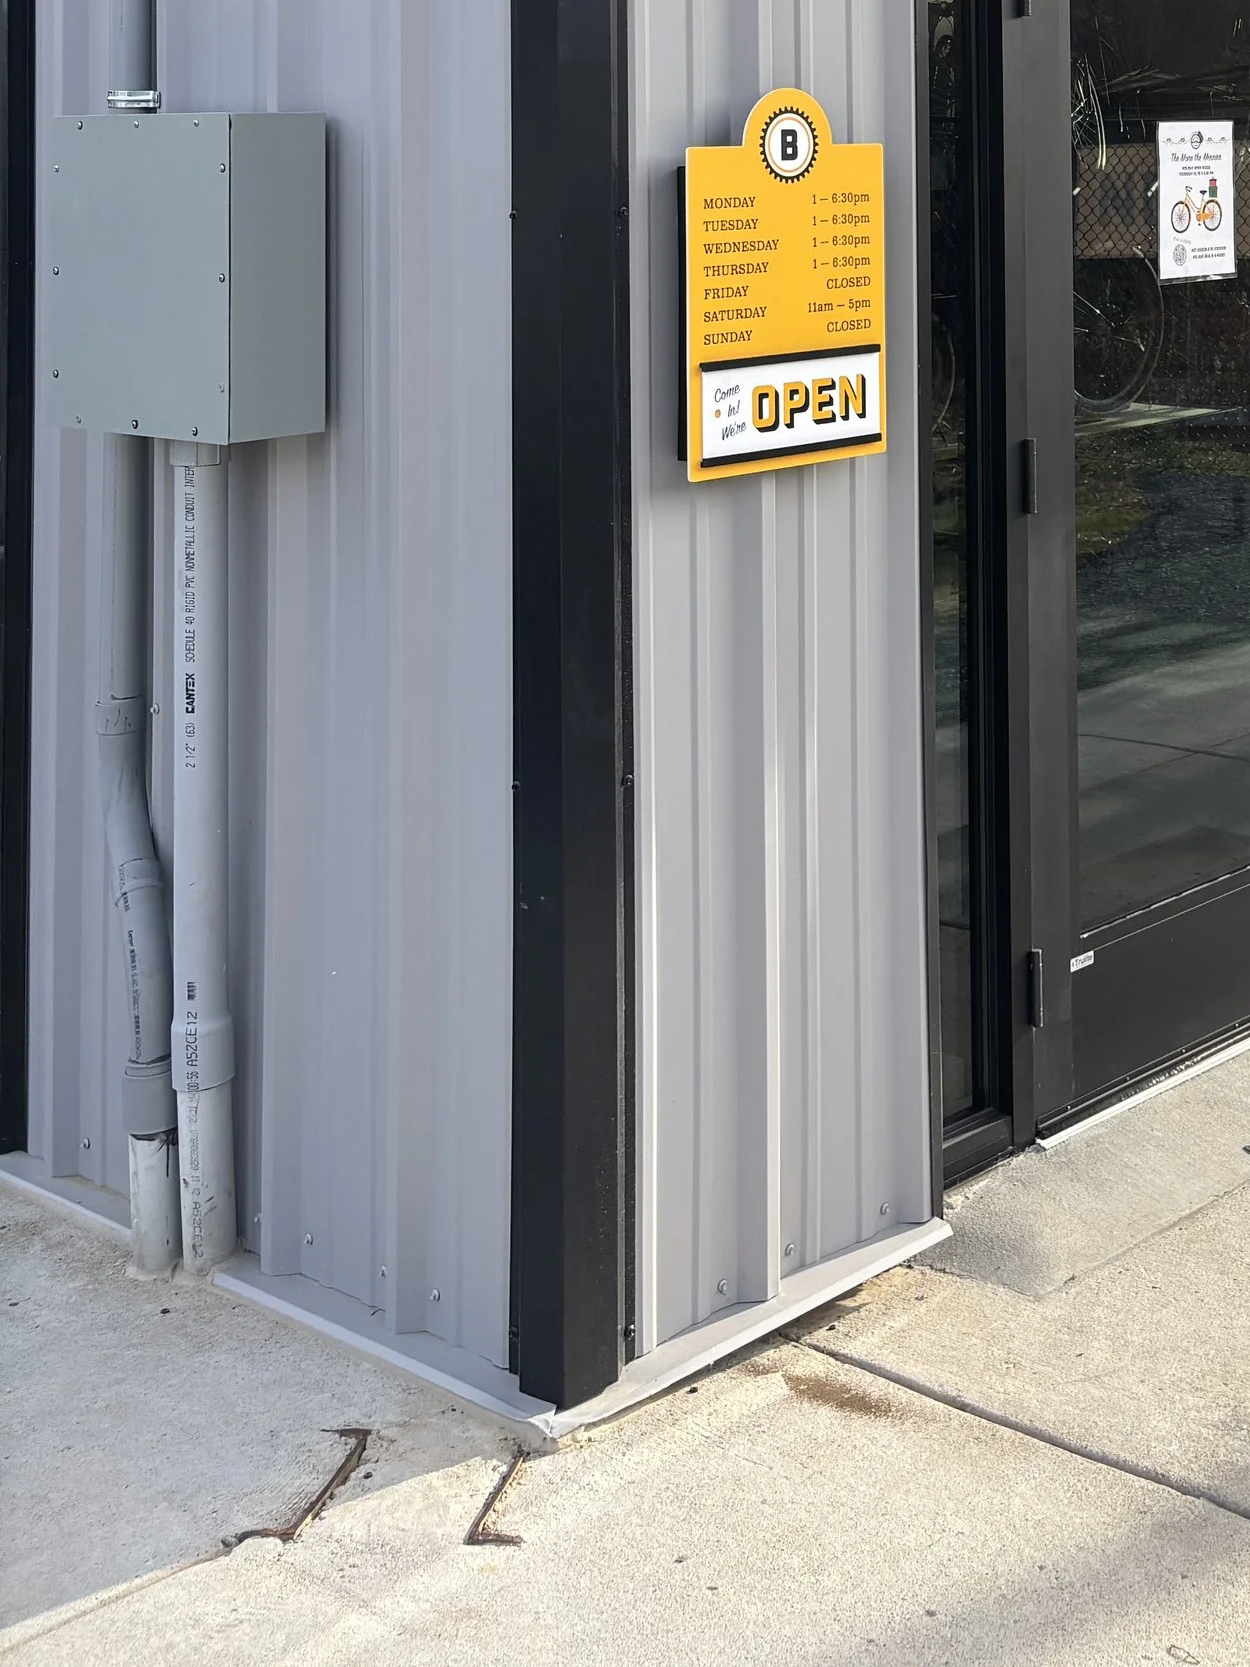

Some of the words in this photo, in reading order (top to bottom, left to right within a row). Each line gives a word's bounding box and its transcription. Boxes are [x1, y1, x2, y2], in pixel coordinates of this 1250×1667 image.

[780, 128, 799, 162] B
[703, 196, 756, 209] MONDAY
[812, 194, 817, 204] 1
[831, 192, 870, 206] 6:30pm
[703, 218, 759, 232] TUESDAY
[813, 215, 817, 226] 1
[832, 214, 870, 227] 6:30pm
[703, 239, 780, 254] WEDNESDAY
[813, 237, 817, 247] 1
[832, 235, 870, 248] 6:30pm
[703, 262, 769, 277] THURSDAY
[813, 259, 817, 269] 1
[832, 256, 870, 269] 6:30pm
[704, 285, 749, 300] FRIDAY
[826, 276, 871, 290] CLOSED
[703, 306, 767, 323] SATURDAY
[807, 302, 834, 313] 11am
[848, 298, 871, 312] 5pm
[703, 330, 753, 346] SUNDAY
[826, 318, 871, 333] CLOSED
[714, 384, 741, 403] Come
[752, 373, 867, 433] OPEN
[727, 399, 741, 418] In!
[721, 421, 747, 441] We're
[185, 492, 195, 522] CONDUIT
[185, 525, 195, 572] NONMETALLIC
[185, 575, 195, 589] PVC
[185, 591, 195, 614] RIGID
[185, 616, 195, 625] 40
[185, 629, 196, 663] SCHEDULE
[185, 672, 196, 714] CANTEX
[185, 722, 196, 738] (63)
[185, 1010, 199, 1067] A52CE12
